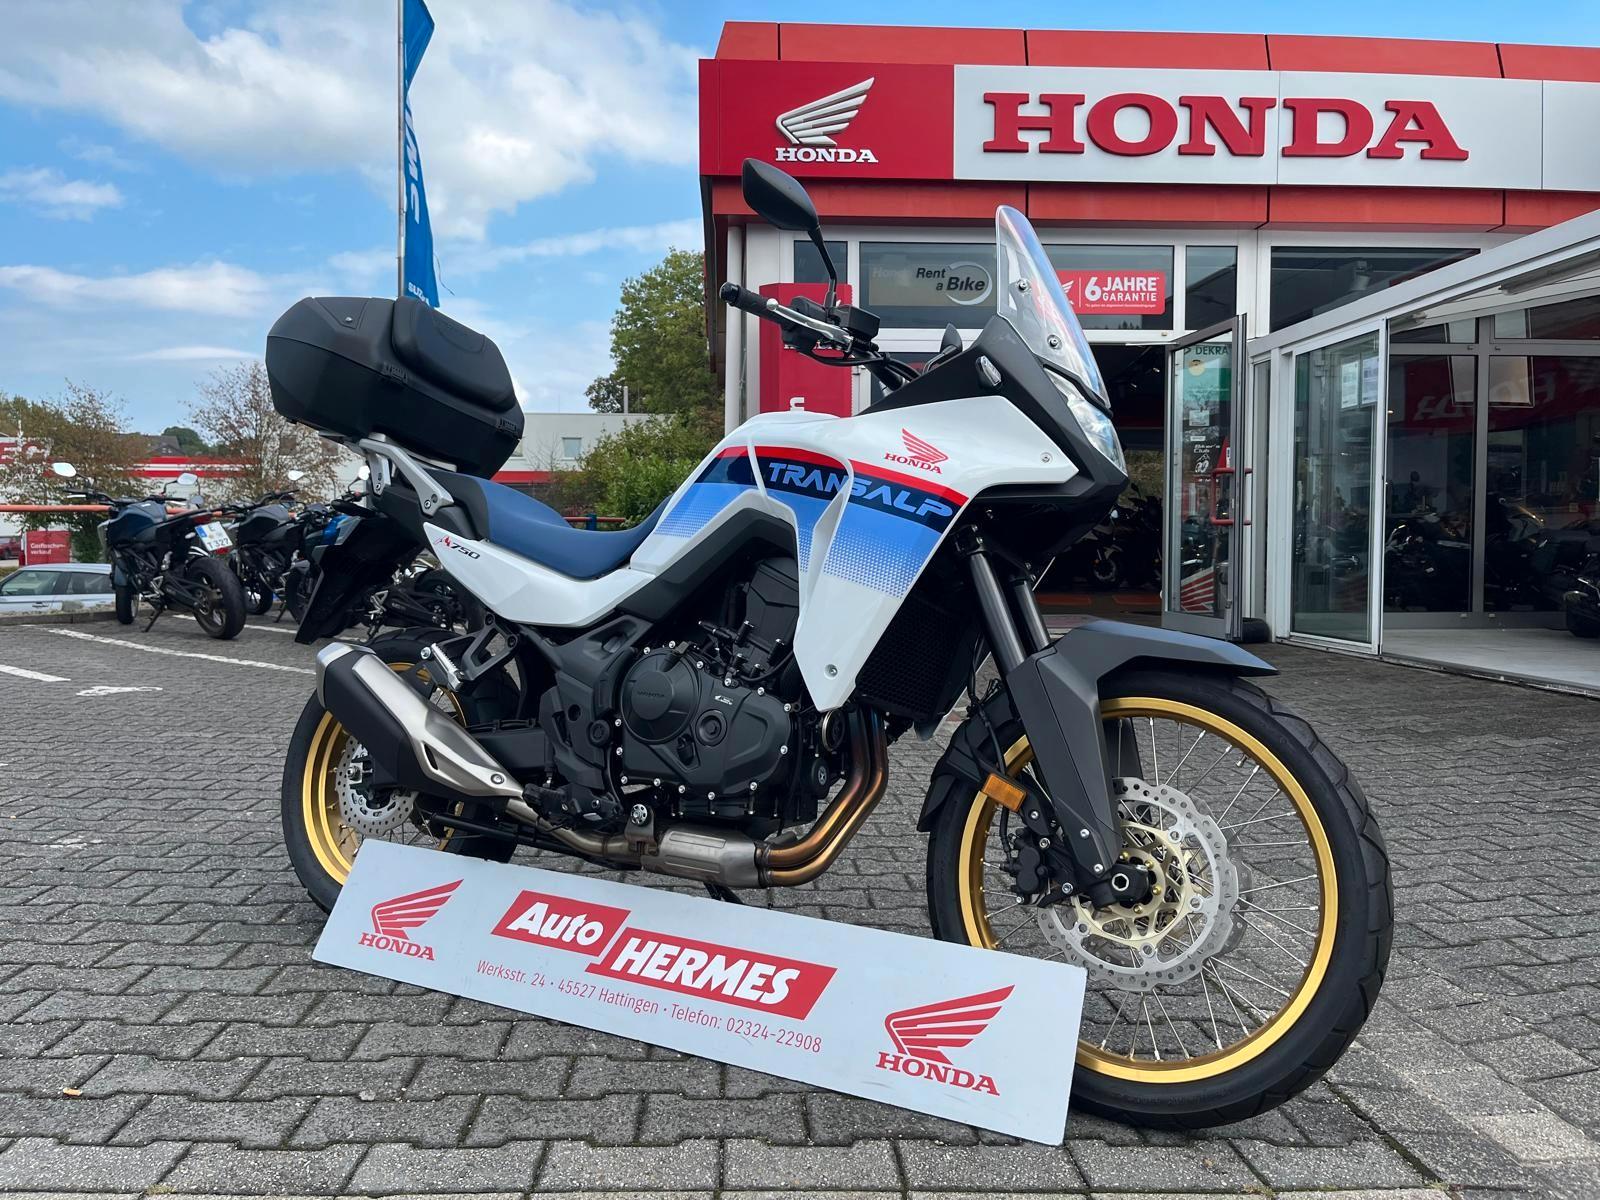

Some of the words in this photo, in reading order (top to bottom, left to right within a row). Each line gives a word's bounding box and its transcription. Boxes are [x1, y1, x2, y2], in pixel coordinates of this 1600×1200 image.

[982, 92, 1469, 161] HONDA
[775, 148, 879, 163] HONDA
[916, 267, 947, 279] Rent
[936, 282, 944, 291] a
[946, 276, 986, 291] Bike
[1084, 276, 1102, 302] 6
[1102, 276, 1158, 292] JAHRE
[1102, 292, 1157, 302] GARANTIE
[1195, 345, 1229, 355] DEKRA
[884, 452, 943, 475] HONDA
[768, 462, 953, 518] TRANSALP
[506, 901, 604, 946] Auto
[358, 932, 435, 961] HONDA
[610, 937, 801, 1006] HERMES
[476, 959, 527, 984] Werksstr.
[530, 972, 546, 988] 24
[558, 978, 596, 999] 45527
[599, 987, 660, 1014] Hattingen
[670, 1003, 723, 1029] Telefon:
[726, 1017, 822, 1053] 02324-22908
[876, 1051, 1000, 1097] HONDA
